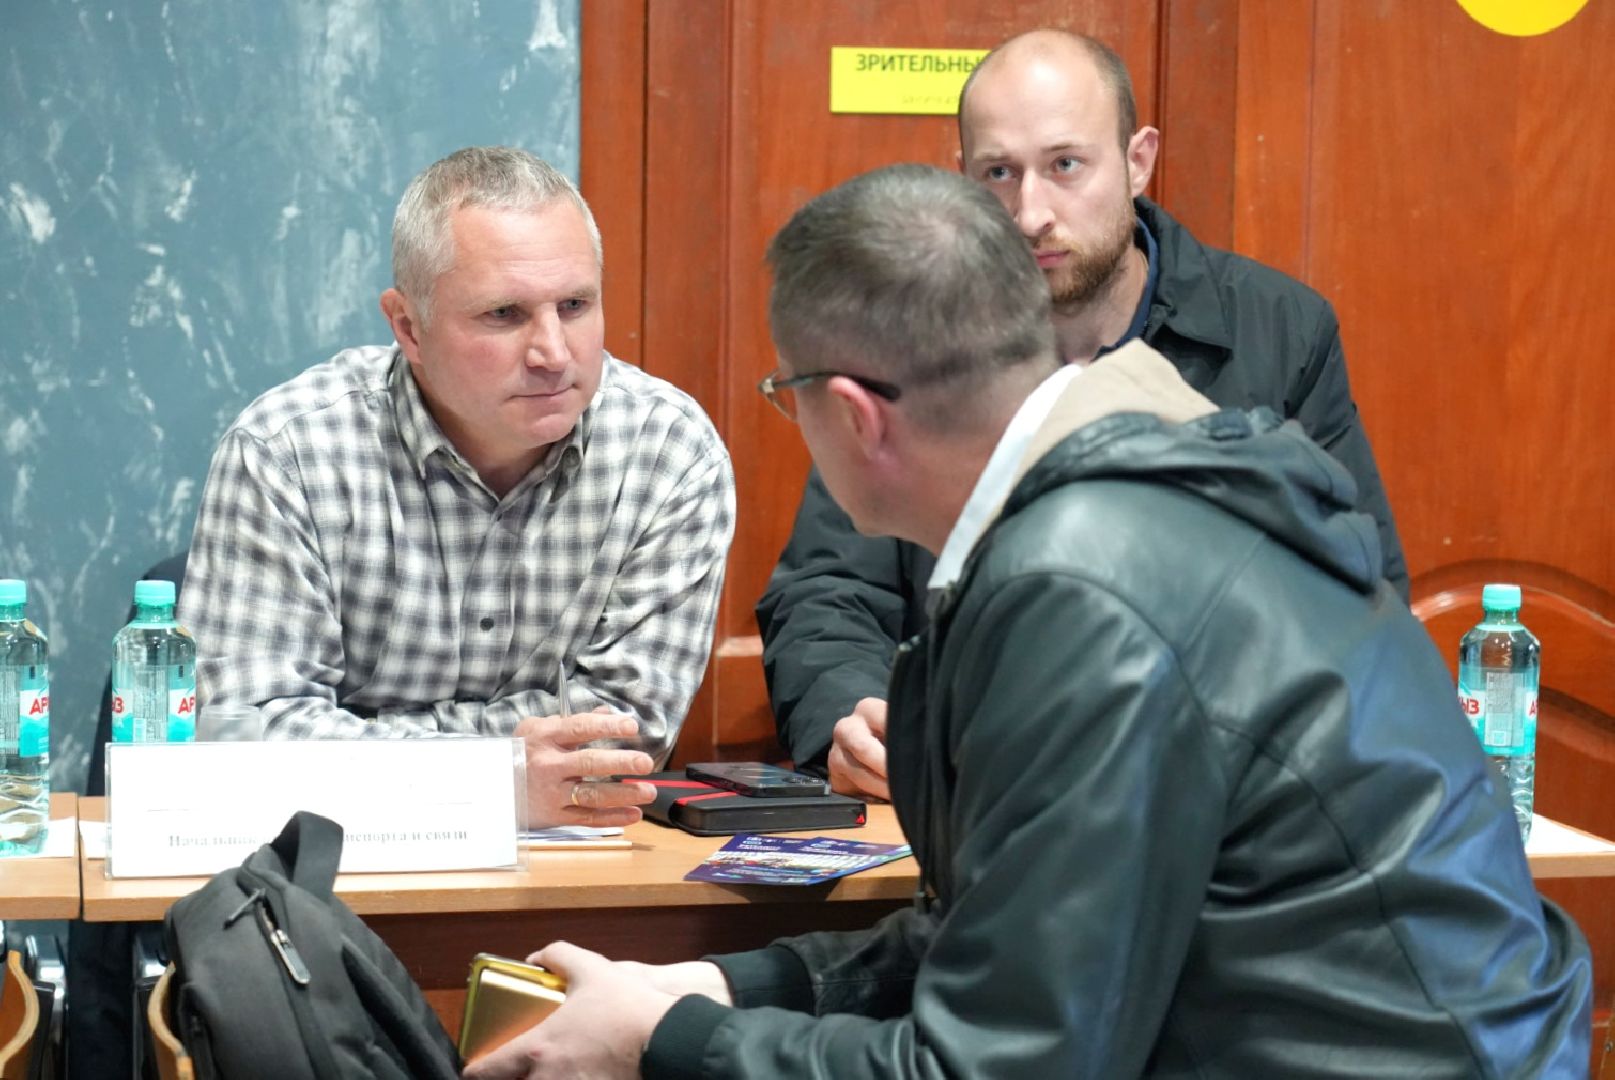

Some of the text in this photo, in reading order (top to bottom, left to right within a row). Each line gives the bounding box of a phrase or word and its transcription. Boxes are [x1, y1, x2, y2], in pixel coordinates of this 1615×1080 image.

[856, 53, 985, 73] ЗРИТЕЛЬНЫ
[29, 696, 49, 715] АР
[177, 696, 196, 714] АР
[344, 832, 407, 844] нспорта
